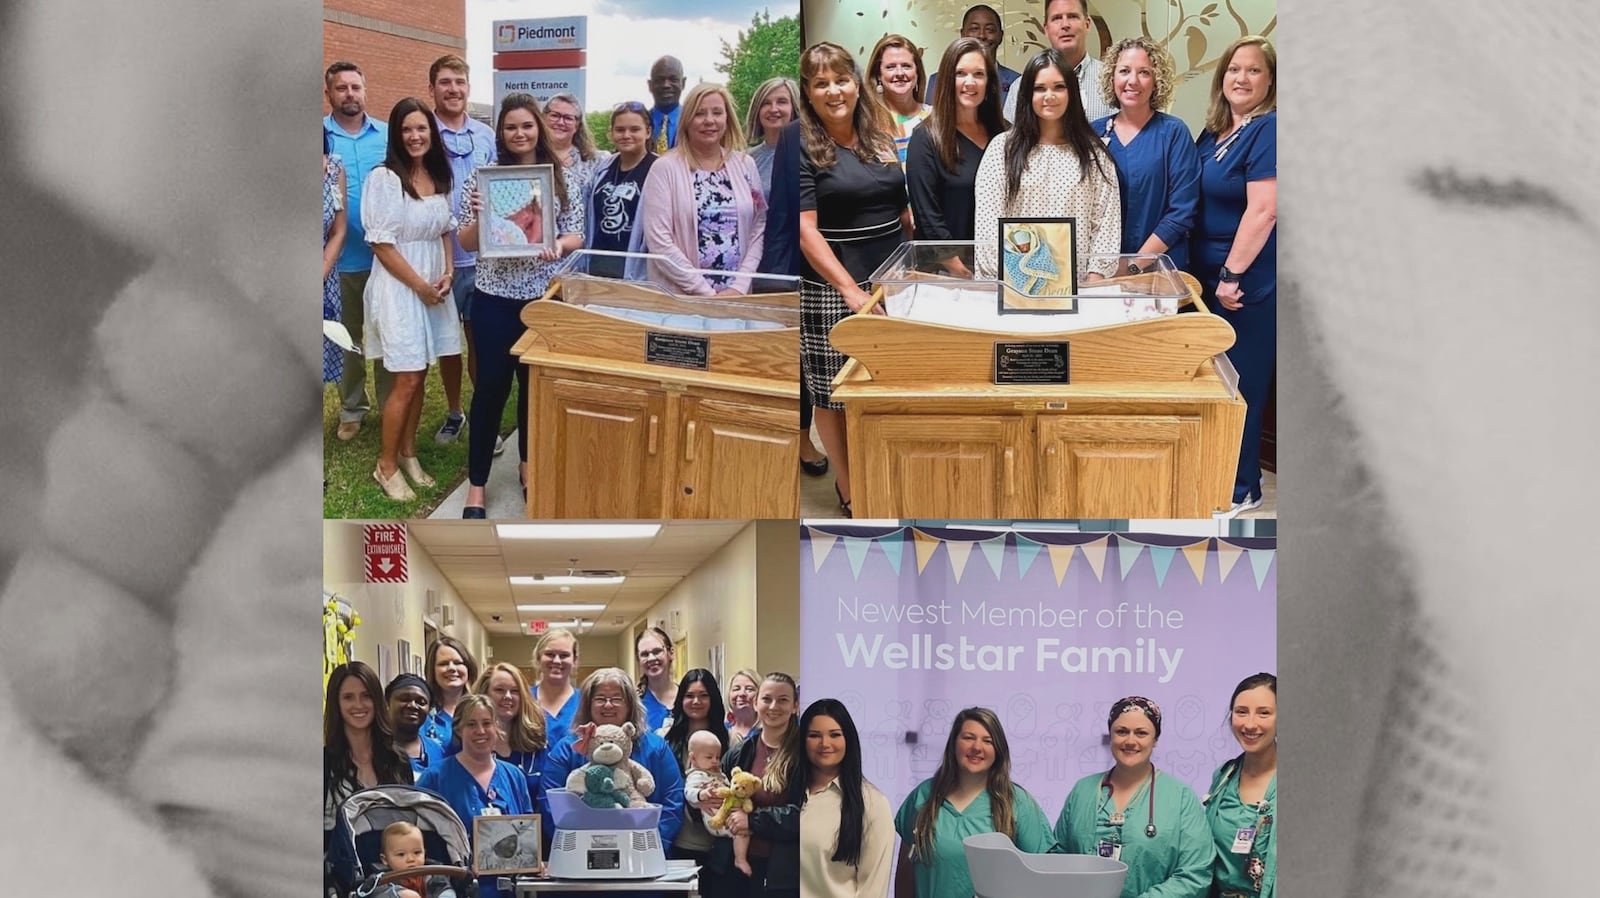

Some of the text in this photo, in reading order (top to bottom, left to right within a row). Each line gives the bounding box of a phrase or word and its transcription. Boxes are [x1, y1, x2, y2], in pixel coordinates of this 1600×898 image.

[518, 25, 576, 39] Piedmont
[505, 80, 569, 90] North Entrance
[374, 531, 396, 542] FIRE
[366, 544, 405, 554] EXTINGUISHER
[838, 596, 1184, 629] Newest Member of the
[835, 632, 1184, 684] Wellstar Family
